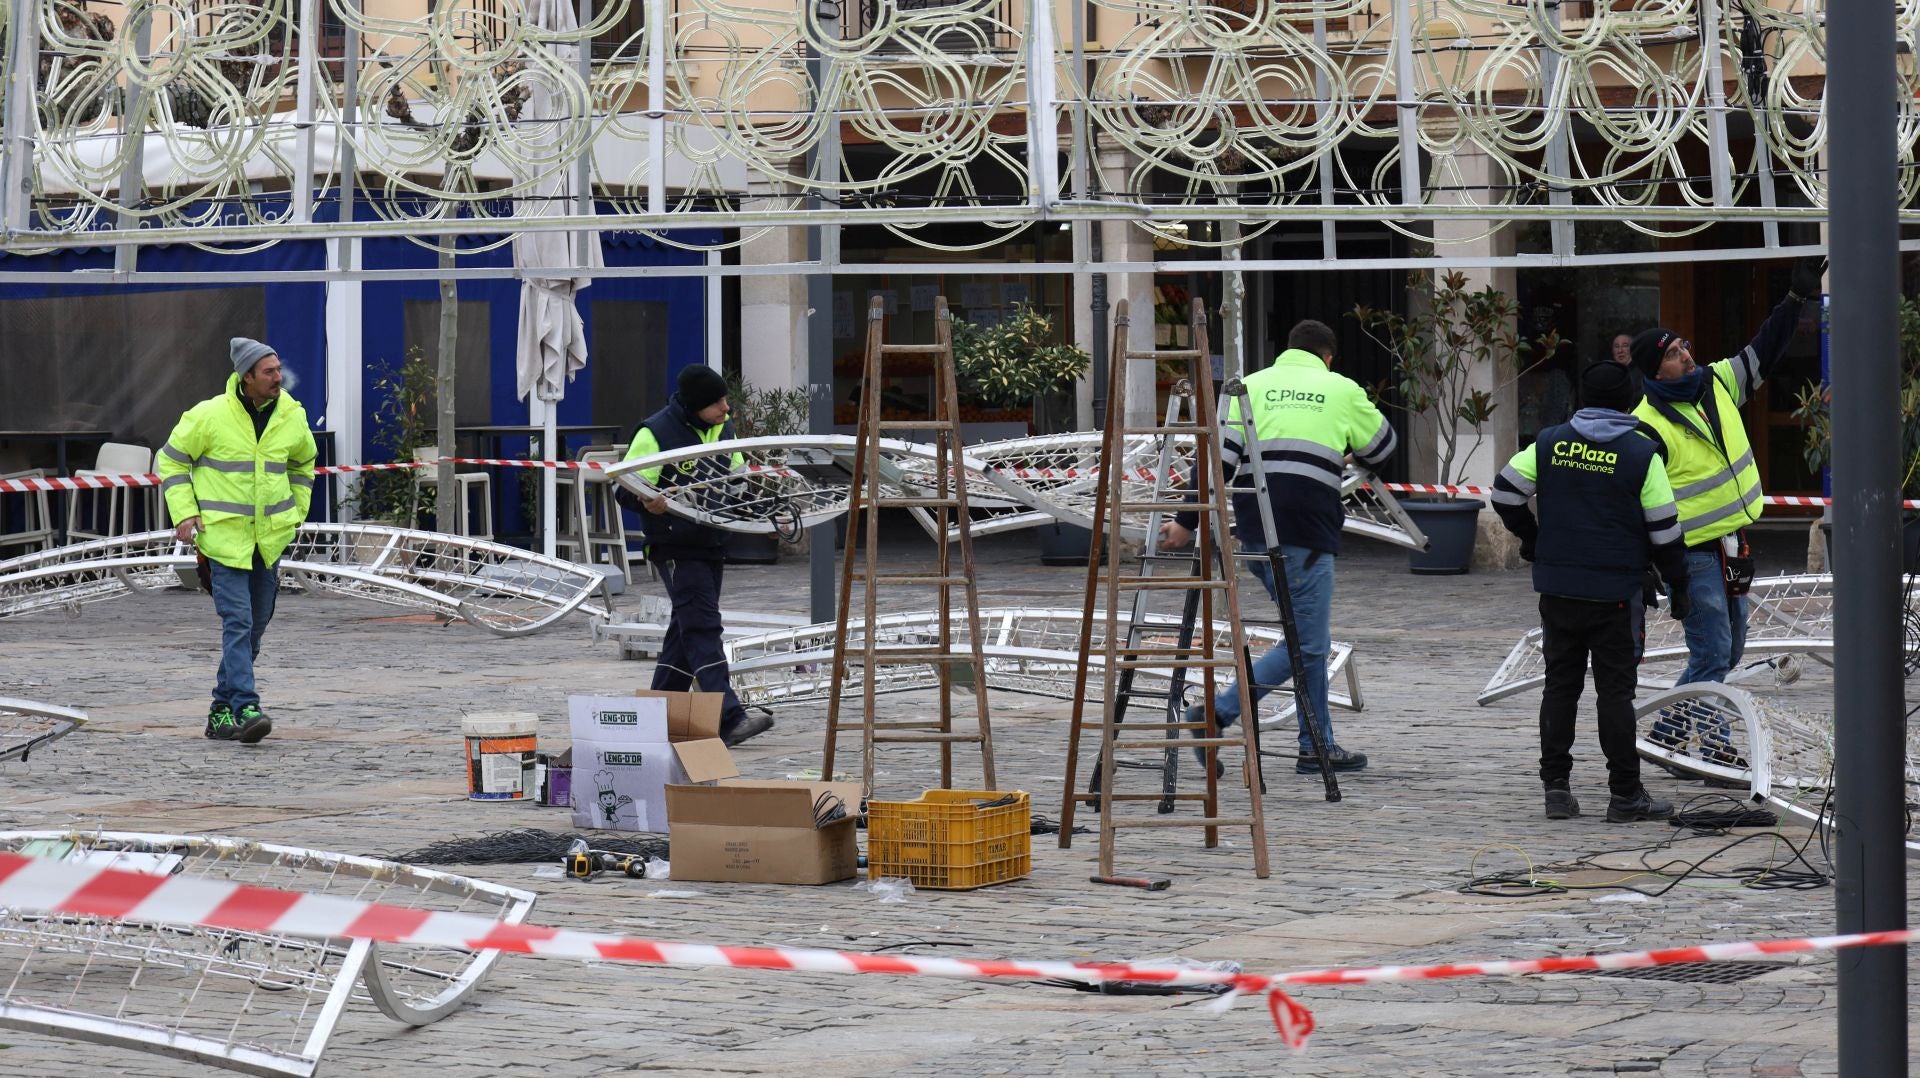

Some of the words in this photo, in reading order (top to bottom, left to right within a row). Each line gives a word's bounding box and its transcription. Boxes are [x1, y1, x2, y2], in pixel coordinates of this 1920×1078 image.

[1265, 389, 1325, 404] C.Plaza
[1553, 441, 1618, 464] C.Plaza
[1551, 456, 1615, 474] Iluminaciones
